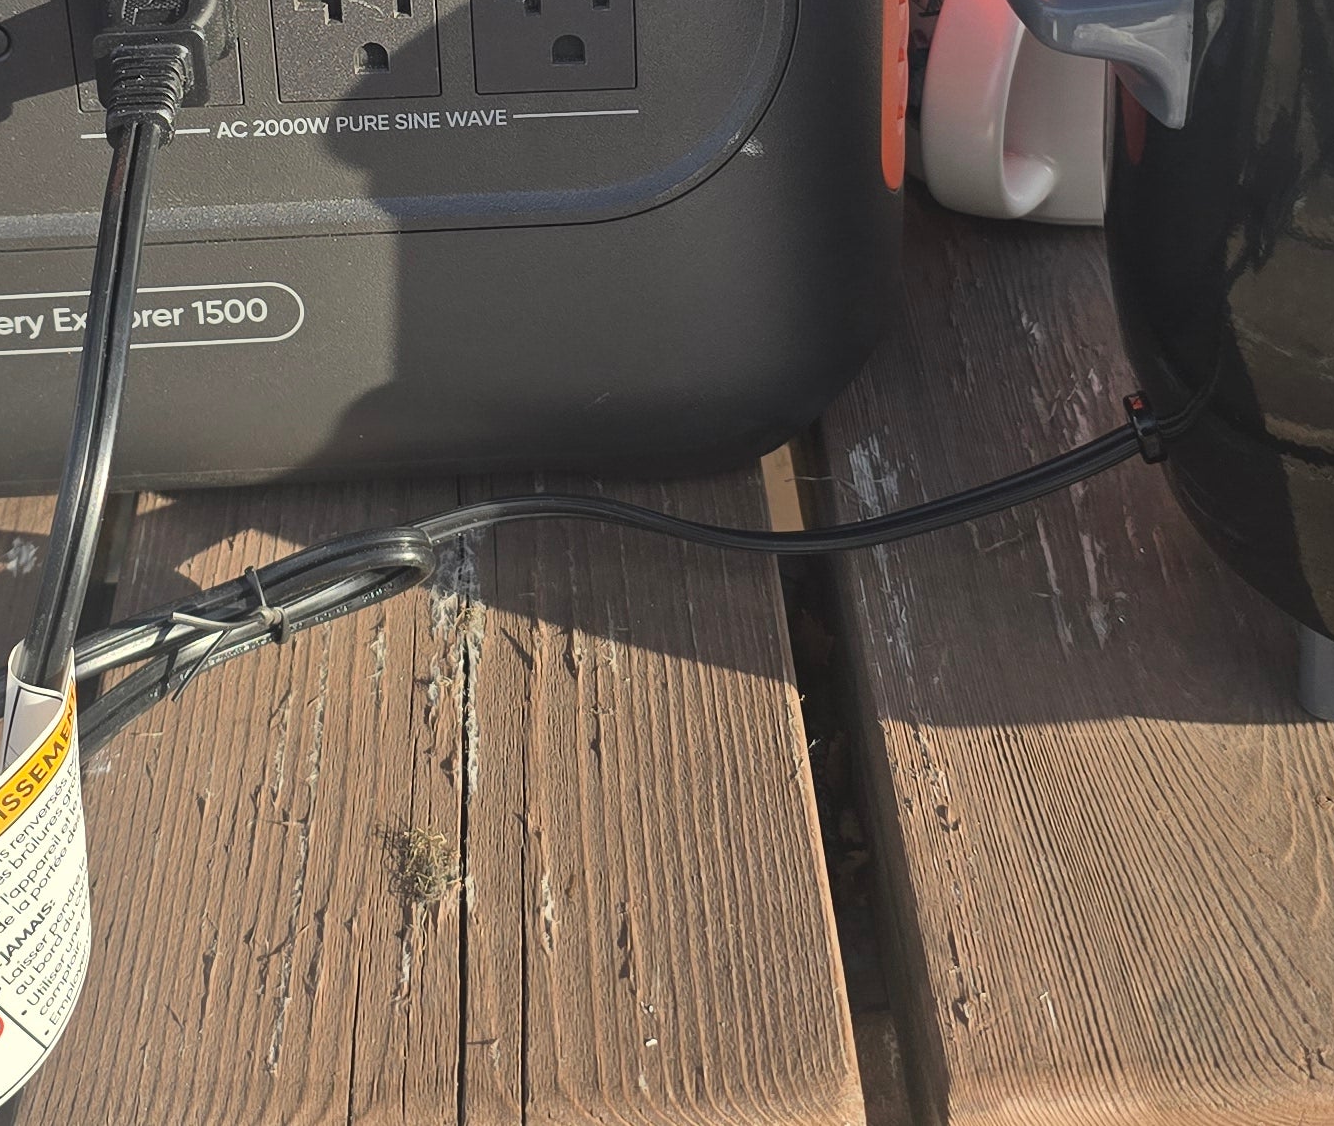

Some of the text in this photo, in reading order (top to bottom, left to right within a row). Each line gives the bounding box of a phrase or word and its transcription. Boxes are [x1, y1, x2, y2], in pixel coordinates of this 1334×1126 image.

[217, 108, 507, 139] AC 2000W PURE SINE WAVE
[53, 305, 185, 333] Exorer
[191, 296, 268, 326] 1500
[8, 808, 63, 870] brûlures
[10, 778, 67, 850] renversés
[0, 834, 61, 906] l'appareil
[62, 817, 71, 834] et
[12, 899, 30, 915] la
[31, 847, 67, 902] portée
[0, 899, 55, 966] JAMAIS:
[1, 934, 47, 985] Laisser
[49, 874, 80, 936] pendre
[16, 909, 75, 995] au bord du
[27, 921, 80, 1005] Utiliser une
